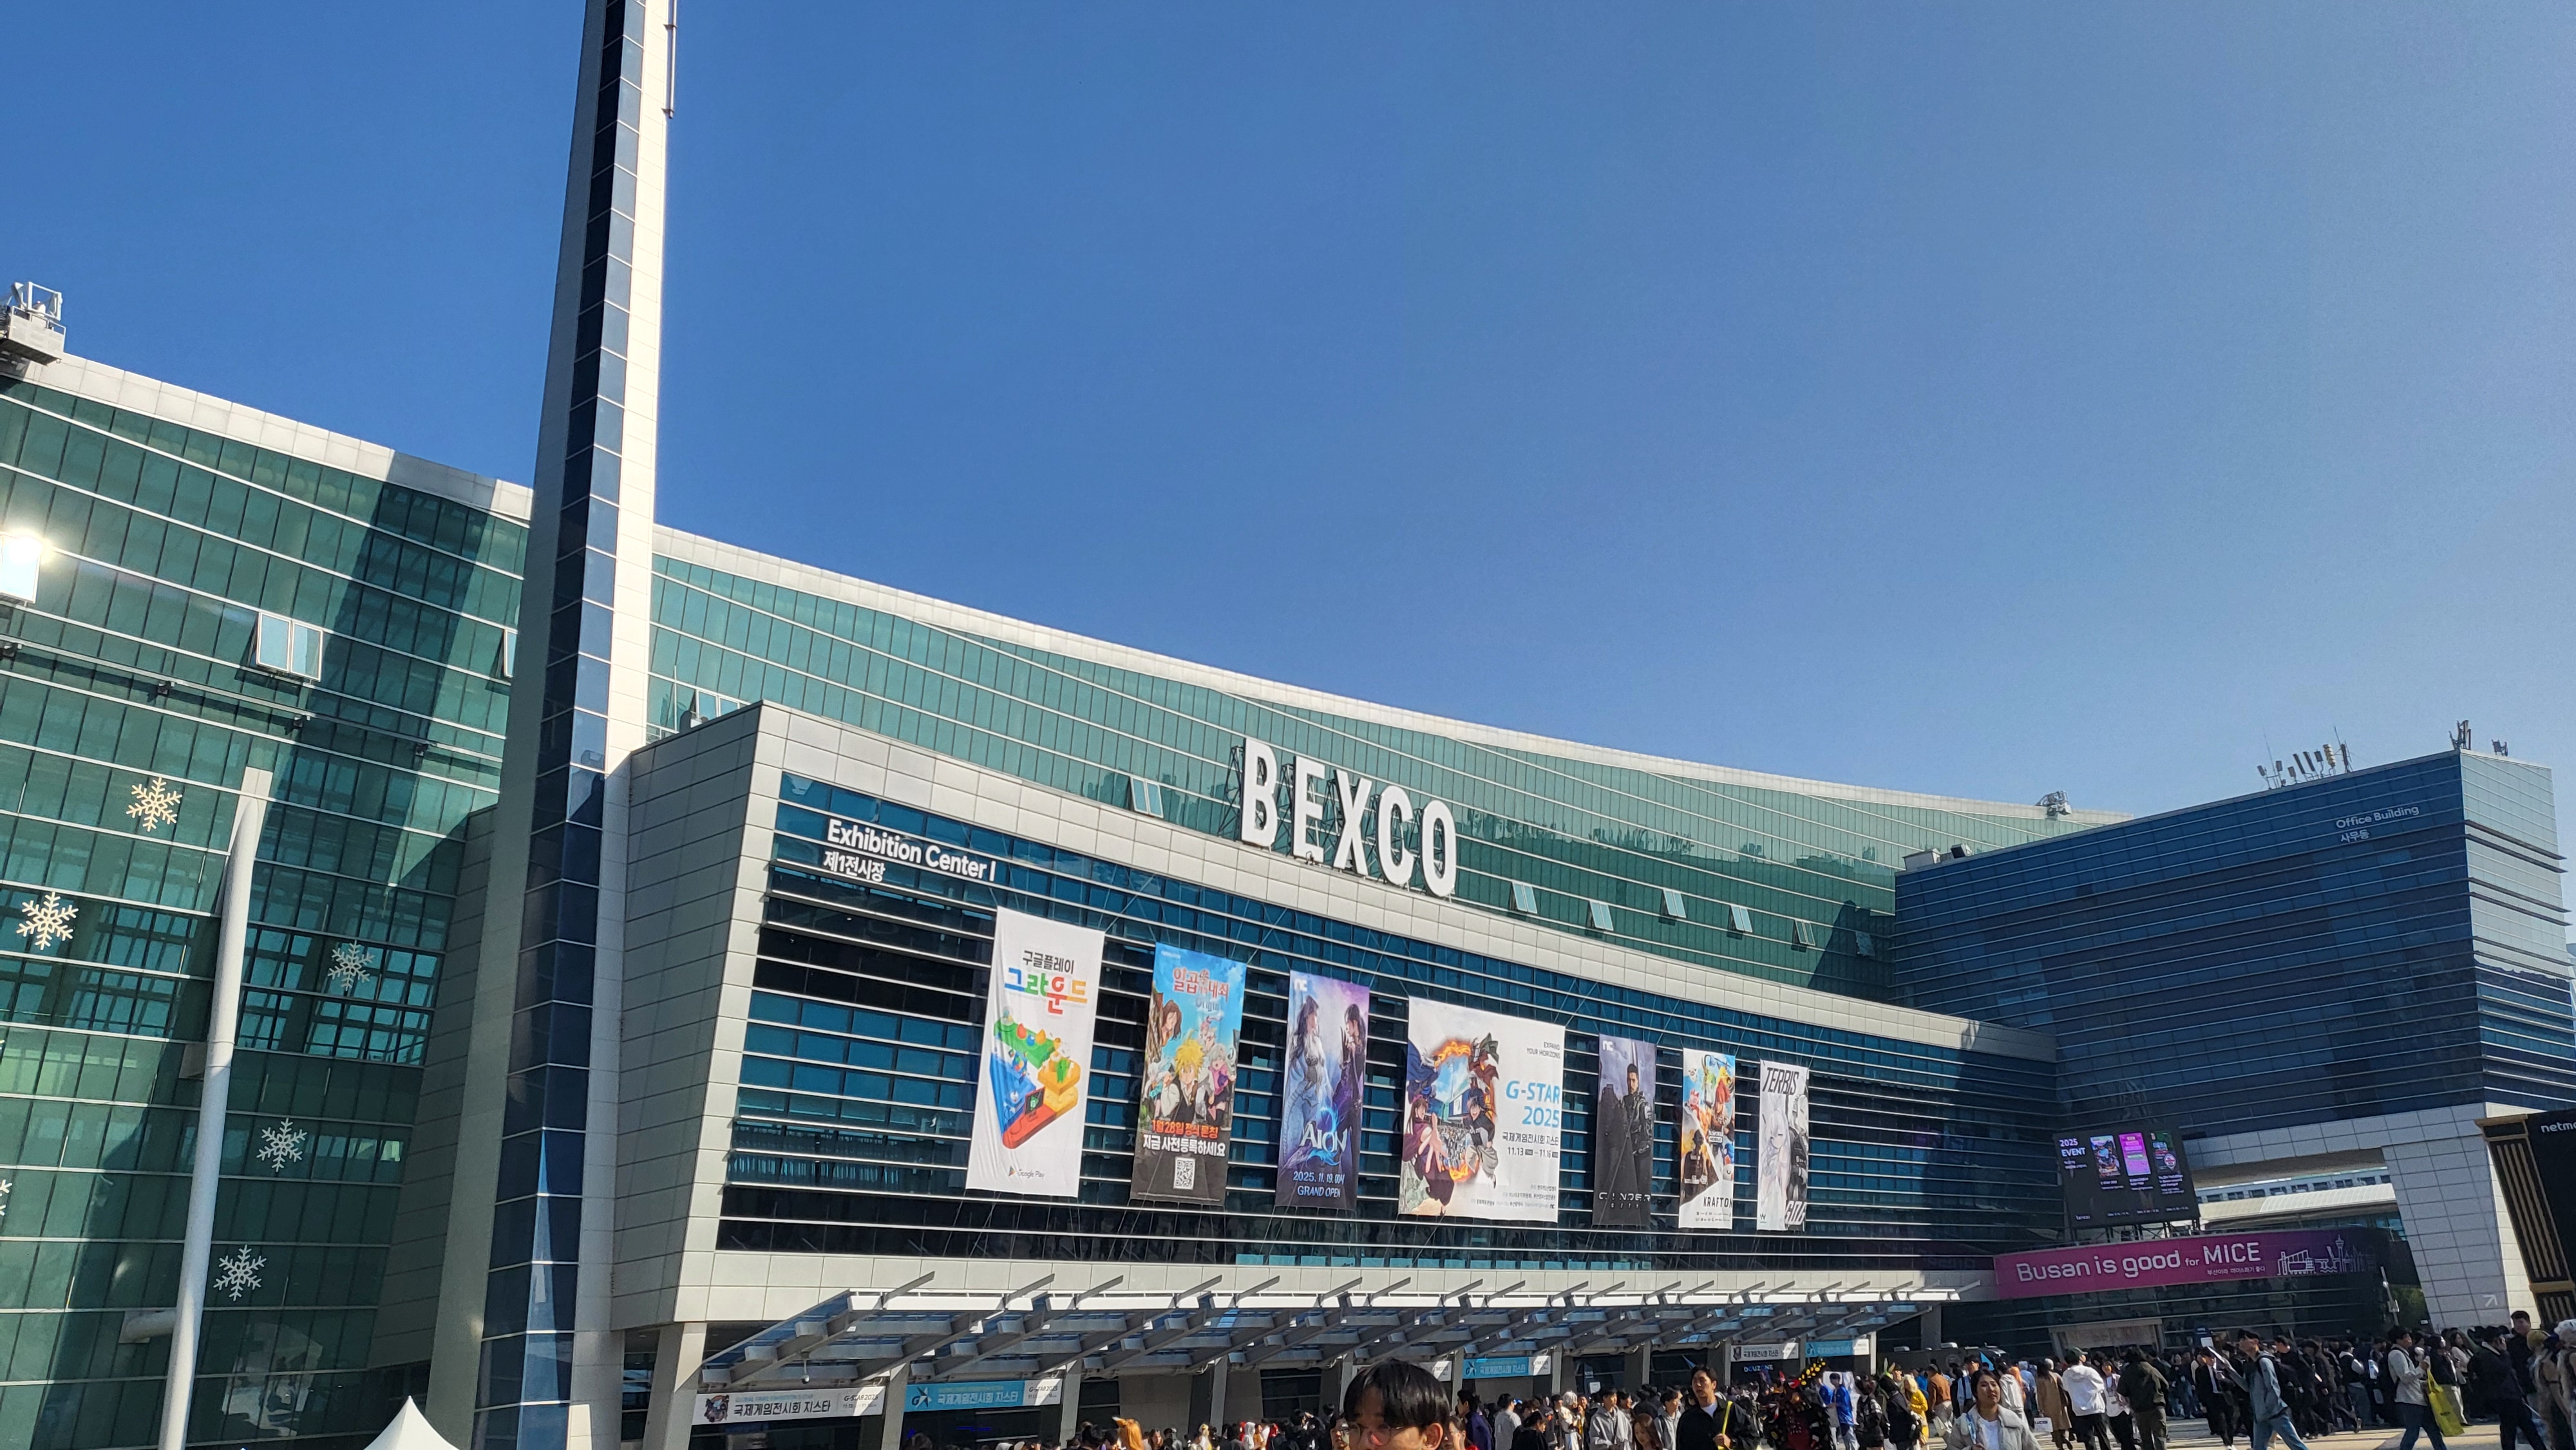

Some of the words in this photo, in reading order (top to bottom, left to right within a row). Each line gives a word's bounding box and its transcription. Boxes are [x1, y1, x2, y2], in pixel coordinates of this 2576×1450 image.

[1241, 738, 1457, 897] BEXCO
[2336, 816, 2372, 829] Office
[2373, 806, 2420, 822] Building
[2340, 829, 2369, 843] 사무동
[827, 818, 922, 863] Exhibition
[925, 845, 987, 879] Center
[823, 851, 886, 882] 제1전시장
[1023, 950, 1074, 974] 구글플레이
[1004, 967, 1088, 1015] 그라운드
[1173, 968, 1198, 994] 일곱
[1208, 979, 1229, 1004] 대죄
[1195, 997, 1222, 1012] Origin
[1539, 1050, 1560, 1059] HORIZONS
[1543, 1042, 1560, 1051] EXPAND
[1762, 1067, 1799, 1095] TERBIS
[1506, 1080, 1560, 1104] G-STAR
[1522, 1106, 1560, 1128] 2025
[1151, 1120, 1164, 1134] 1월
[1164, 1122, 1184, 1136] 28일
[1185, 1123, 1200, 1138] 정식
[1201, 1125, 1218, 1139] 론칭
[1298, 1122, 1348, 1153] AION
[1143, 1134, 1160, 1151] 지금
[1161, 1136, 1226, 1157] 사전등록하세요
[1502, 1132, 1545, 1144] 국제게임전시회
[2059, 1138, 2078, 1147] 2025
[1508, 1147, 1524, 1156] 11.13
[2061, 1147, 2086, 1157] EVENT
[1019, 1169, 1034, 1179] Google
[1035, 1171, 1045, 1179] Play
[1293, 1171, 1316, 1183] 2025.
[1297, 1185, 1324, 1196] GRAND
[1325, 1187, 1340, 1198] OPEN
[1599, 1192, 1651, 1202] CINDER
[1703, 1196, 1732, 1209] KRAFTON
[2016, 1262, 2091, 1282] Busan
[2094, 1256, 2117, 1275] is
[2122, 1249, 2181, 1278] good
[2185, 1257, 2200, 1267] for
[2202, 1242, 2262, 1265] MICE
[1743, 1364, 1774, 1373] DOUZONE
[938, 1392, 993, 1405] 국제게임전시회
[995, 1391, 1019, 1403] 지스타
[734, 1402, 801, 1417] 국제게임전시회
[804, 1400, 831, 1413] 지스타
